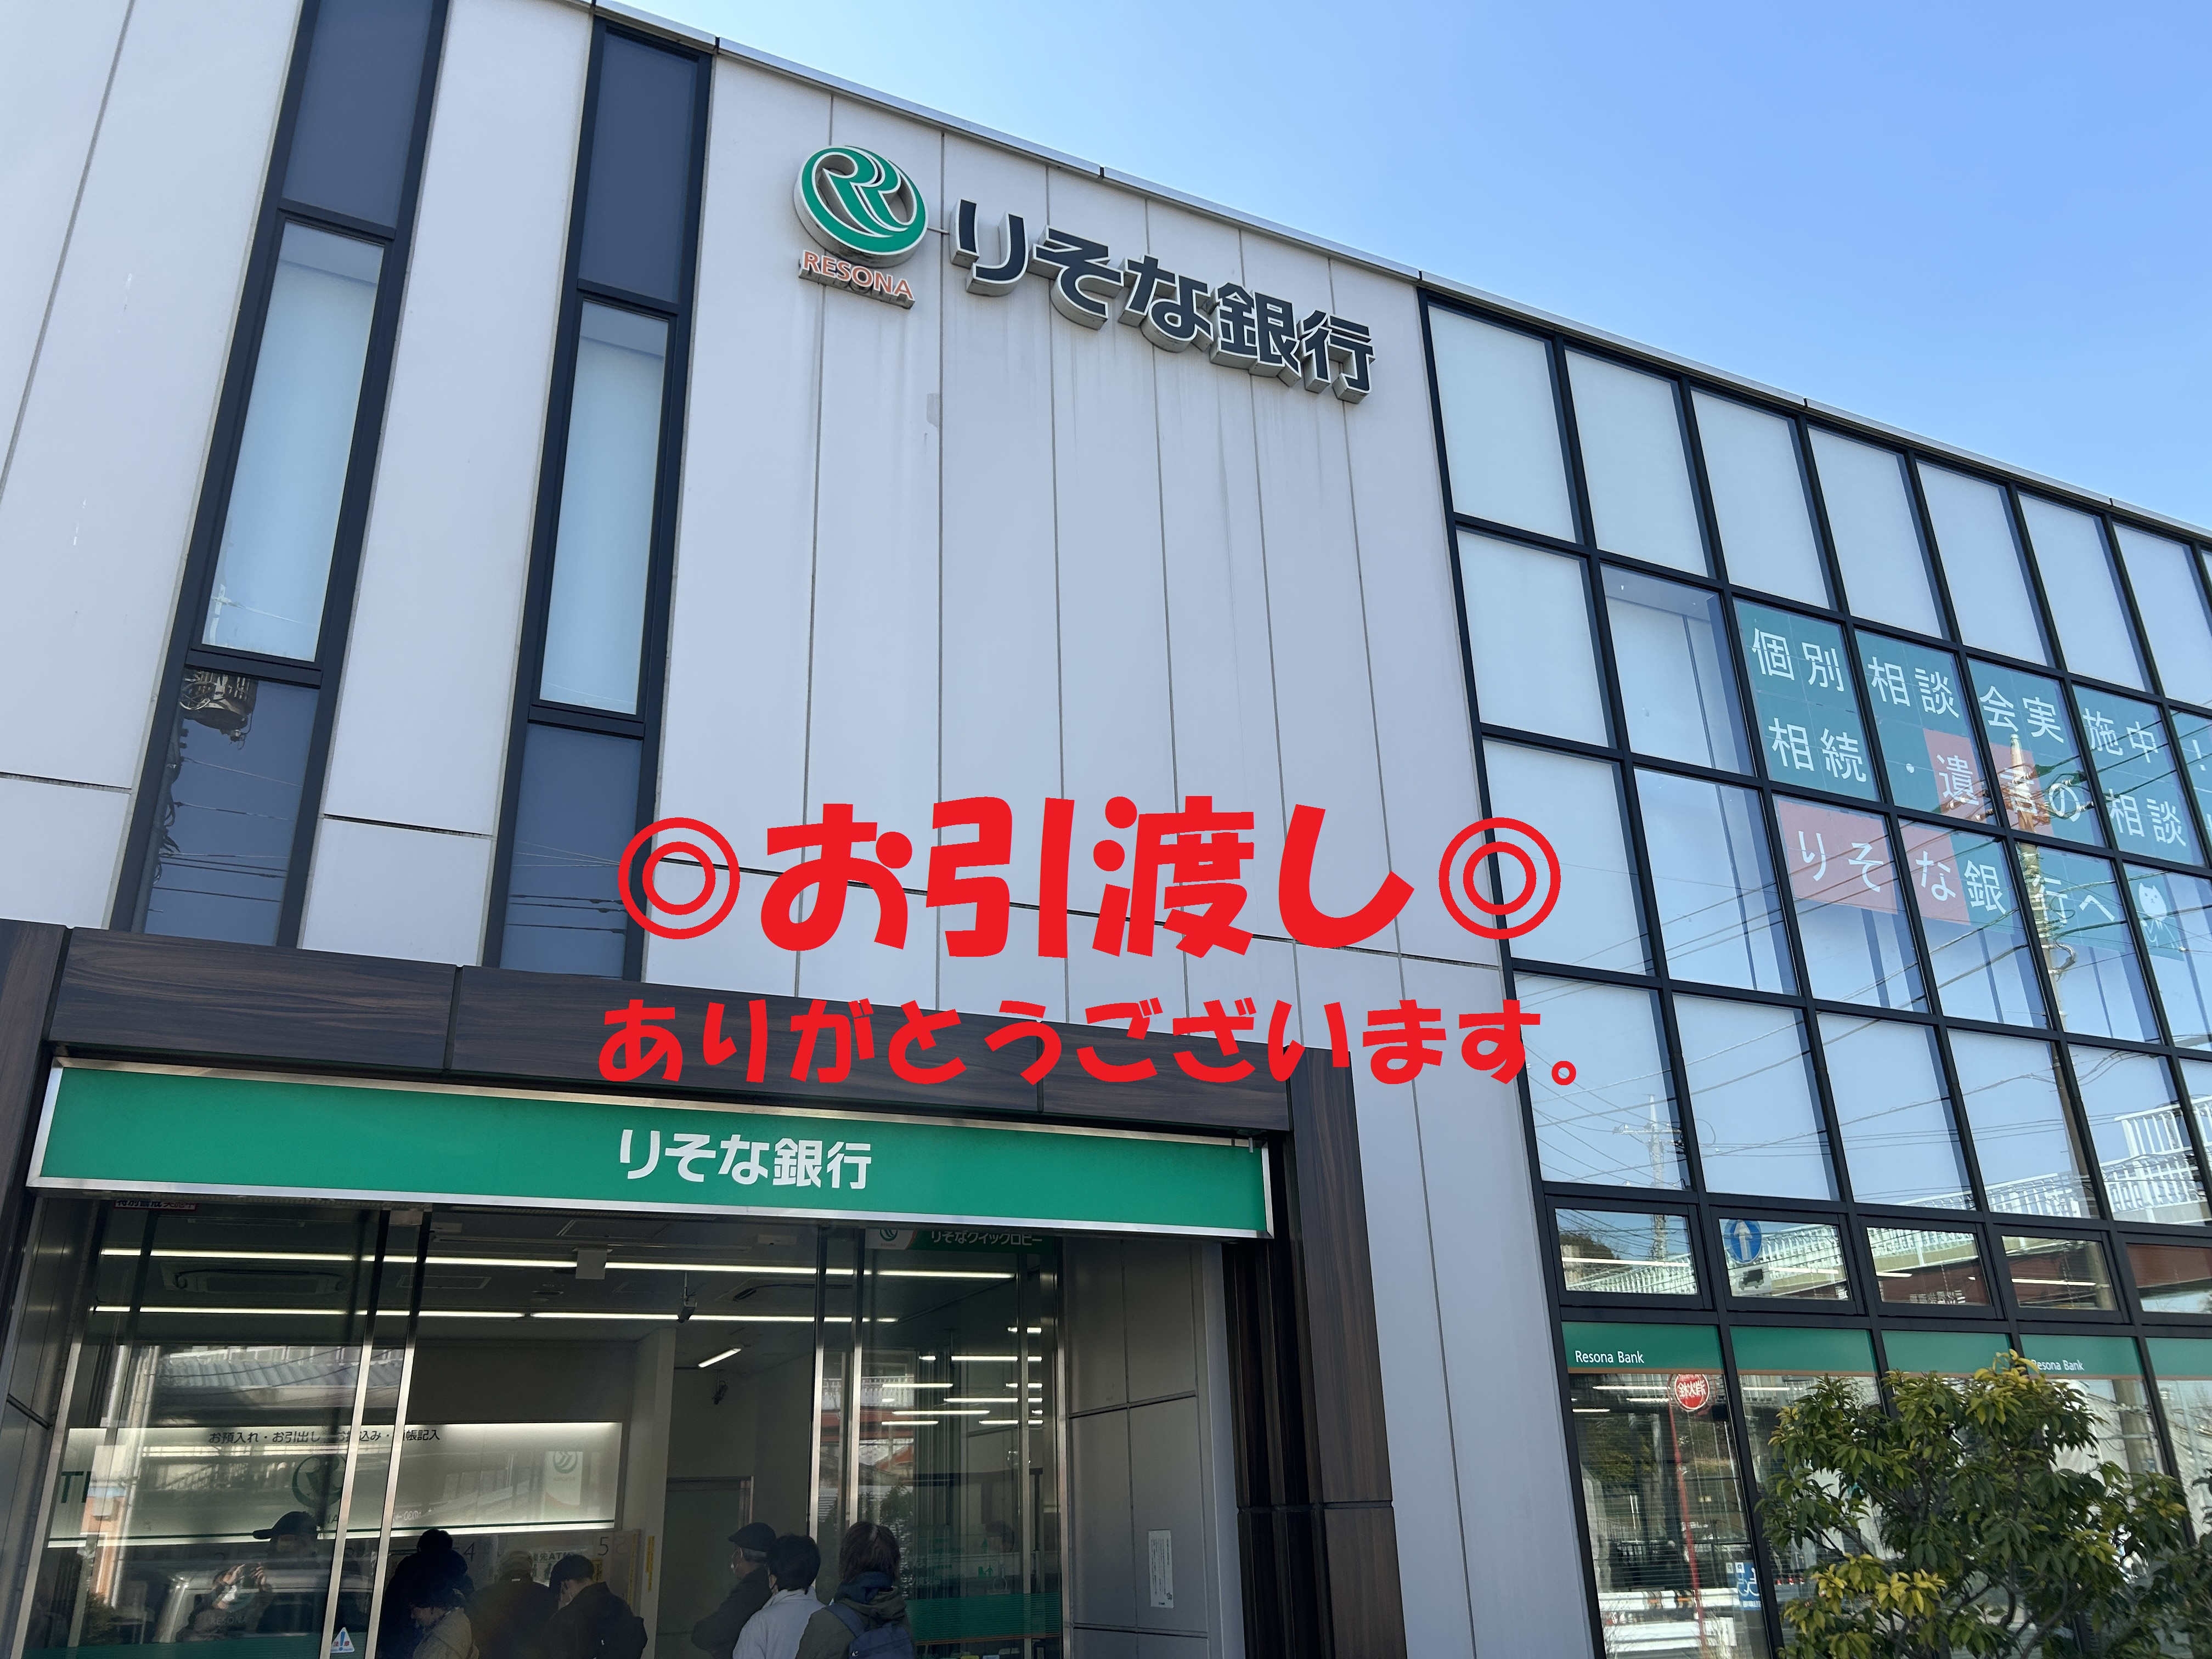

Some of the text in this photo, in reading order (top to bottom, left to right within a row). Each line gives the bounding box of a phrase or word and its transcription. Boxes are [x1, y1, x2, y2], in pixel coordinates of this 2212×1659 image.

[803, 250, 915, 301] RESONA
[956, 198, 1376, 395] りそな銀行
[1768, 717, 2212, 847] 相続・遺言の相談
[620, 1128, 872, 1189] りそな銀行
[1575, 1350, 1645, 1363] Resona Bank
[2062, 1359, 2085, 1371] Bank
